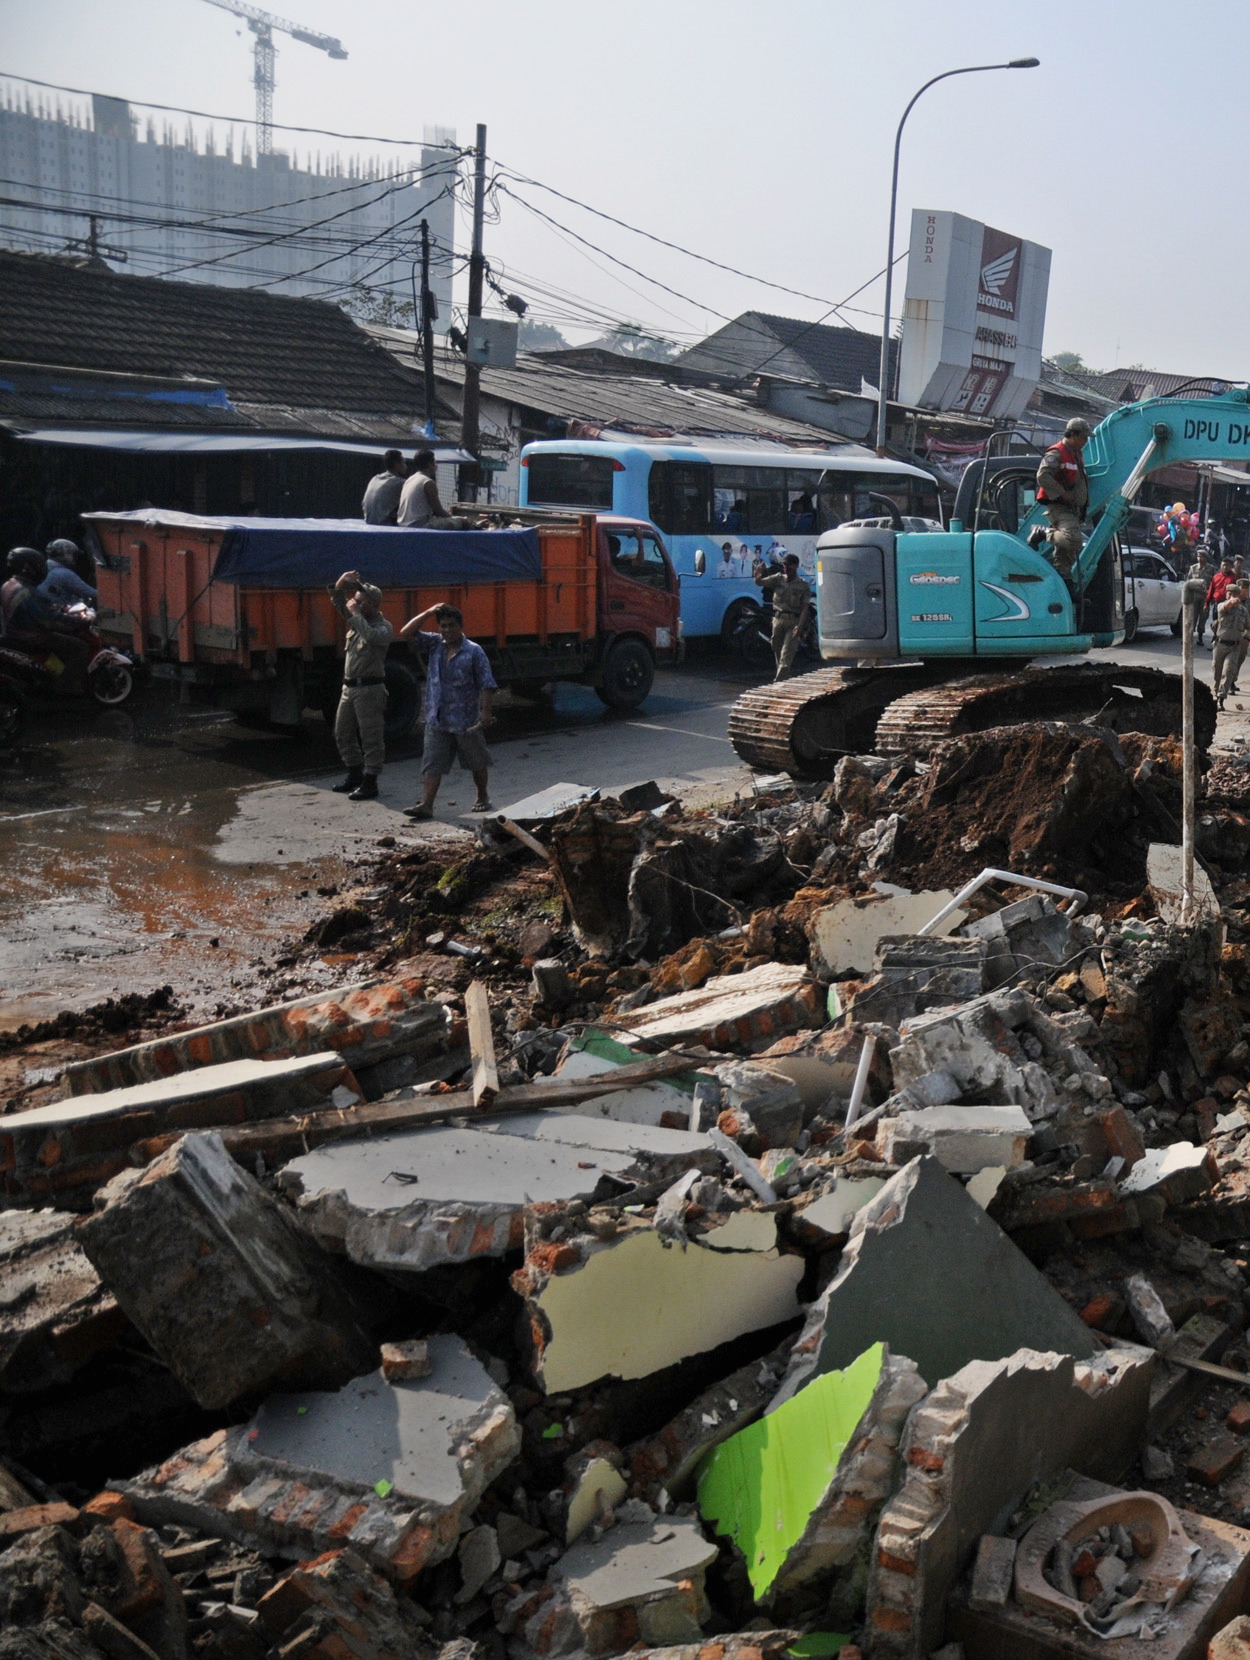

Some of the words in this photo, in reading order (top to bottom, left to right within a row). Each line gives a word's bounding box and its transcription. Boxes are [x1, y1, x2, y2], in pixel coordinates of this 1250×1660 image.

[924, 216, 936, 262] HONDA
[977, 293, 1014, 313] HONDA
[1184, 419, 1219, 442] DPU
